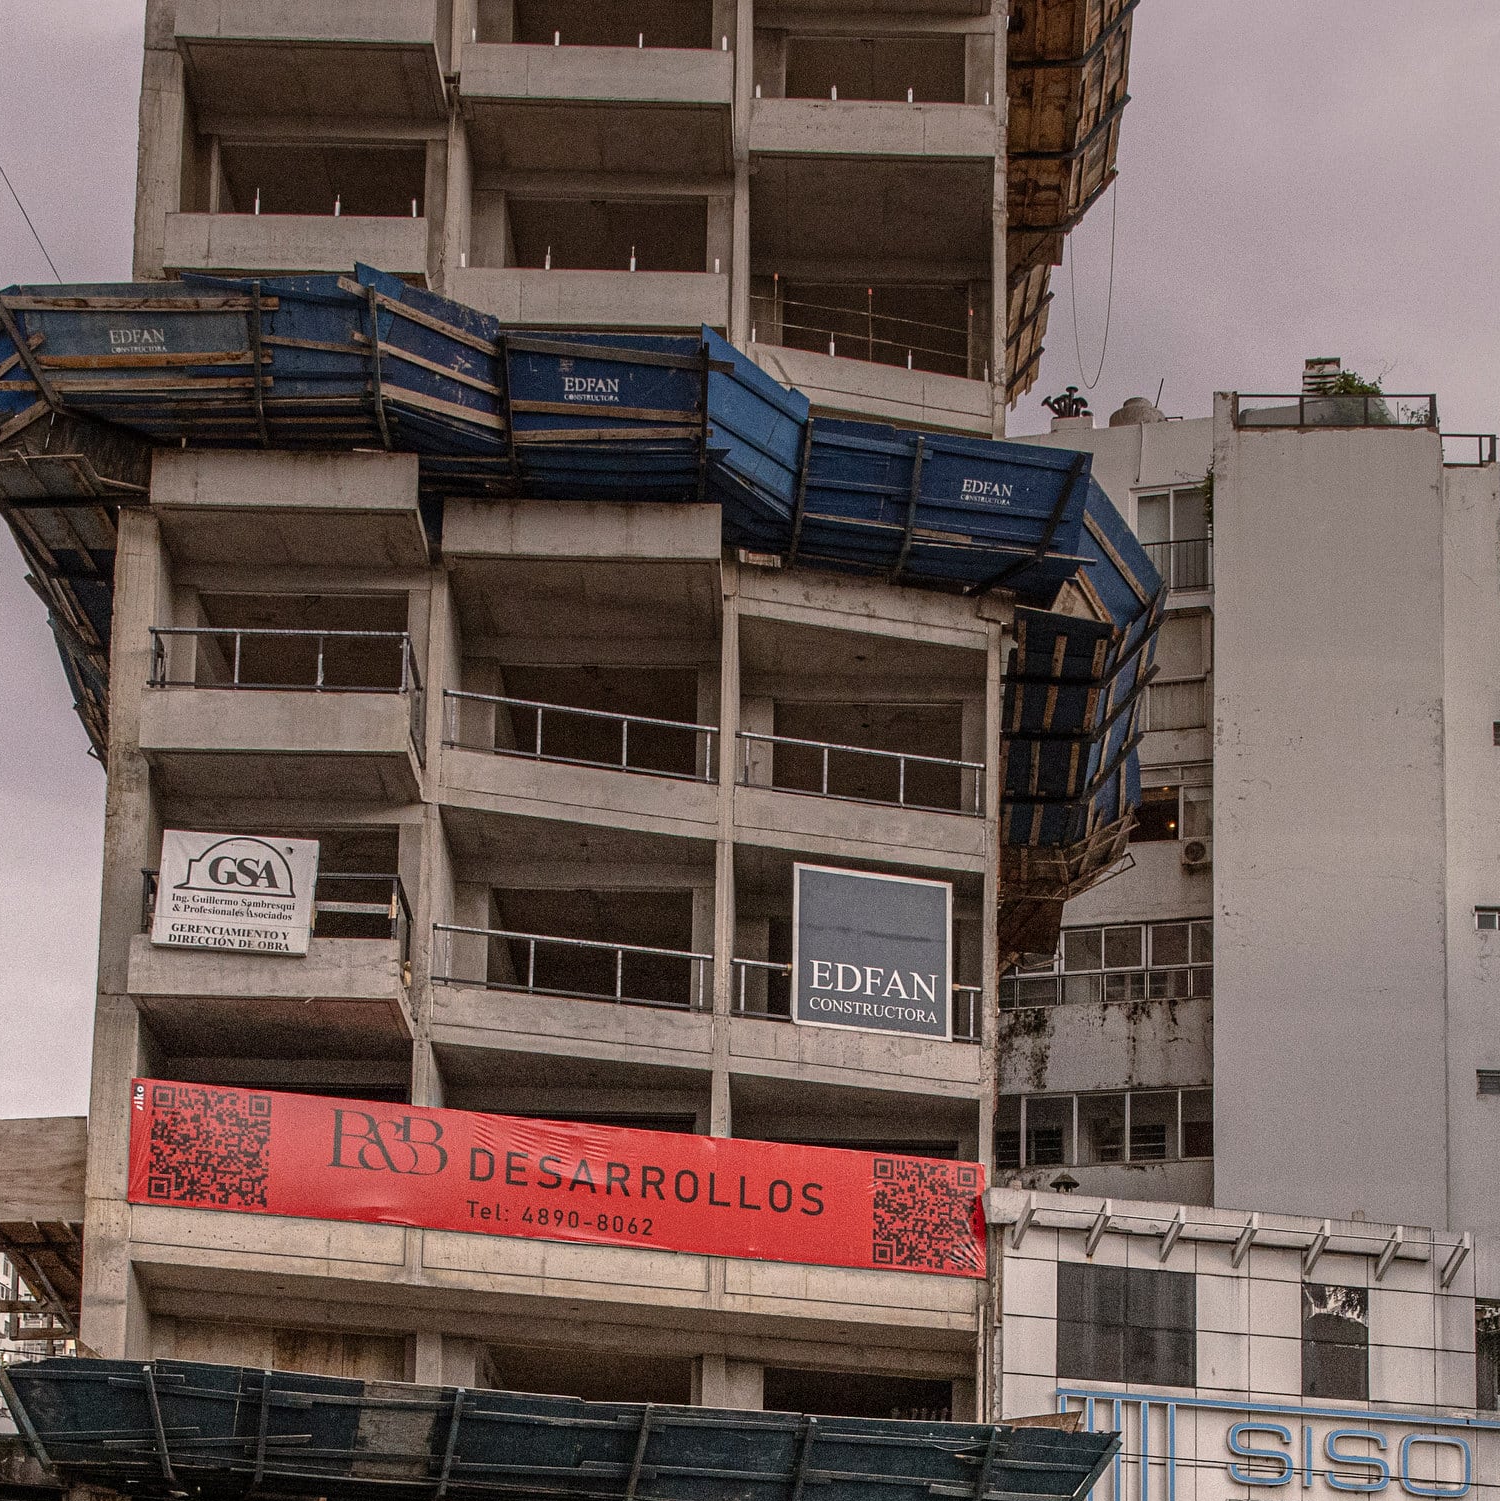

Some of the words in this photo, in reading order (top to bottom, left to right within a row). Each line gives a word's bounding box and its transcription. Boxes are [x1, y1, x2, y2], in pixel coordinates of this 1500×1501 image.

[109, 328, 165, 344] EDFAN
[562, 377, 620, 392] EDFAN
[563, 393, 620, 402] CONSTRUCTORA
[961, 478, 1013, 497] EDFAN
[208, 856, 280, 889] GSA
[171, 893, 191, 904] Ing.
[192, 894, 239, 907] Guillermo
[183, 904, 245, 918] Profesionales
[171, 923, 280, 940] GERENCIAMIENTO
[282, 931, 290, 941] Y
[168, 933, 235, 948] DIRECCIÓN
[257, 941, 290, 952] OBRA
[809, 959, 939, 1003] EDFAN
[809, 996, 938, 1024] CONSTRUCTORA
[468, 1147, 825, 1217] DESARROLLOS
[466, 1200, 509, 1223] Tel:
[521, 1205, 654, 1237] 4890-8062
[1227, 1421, 1472, 1498] SISO
